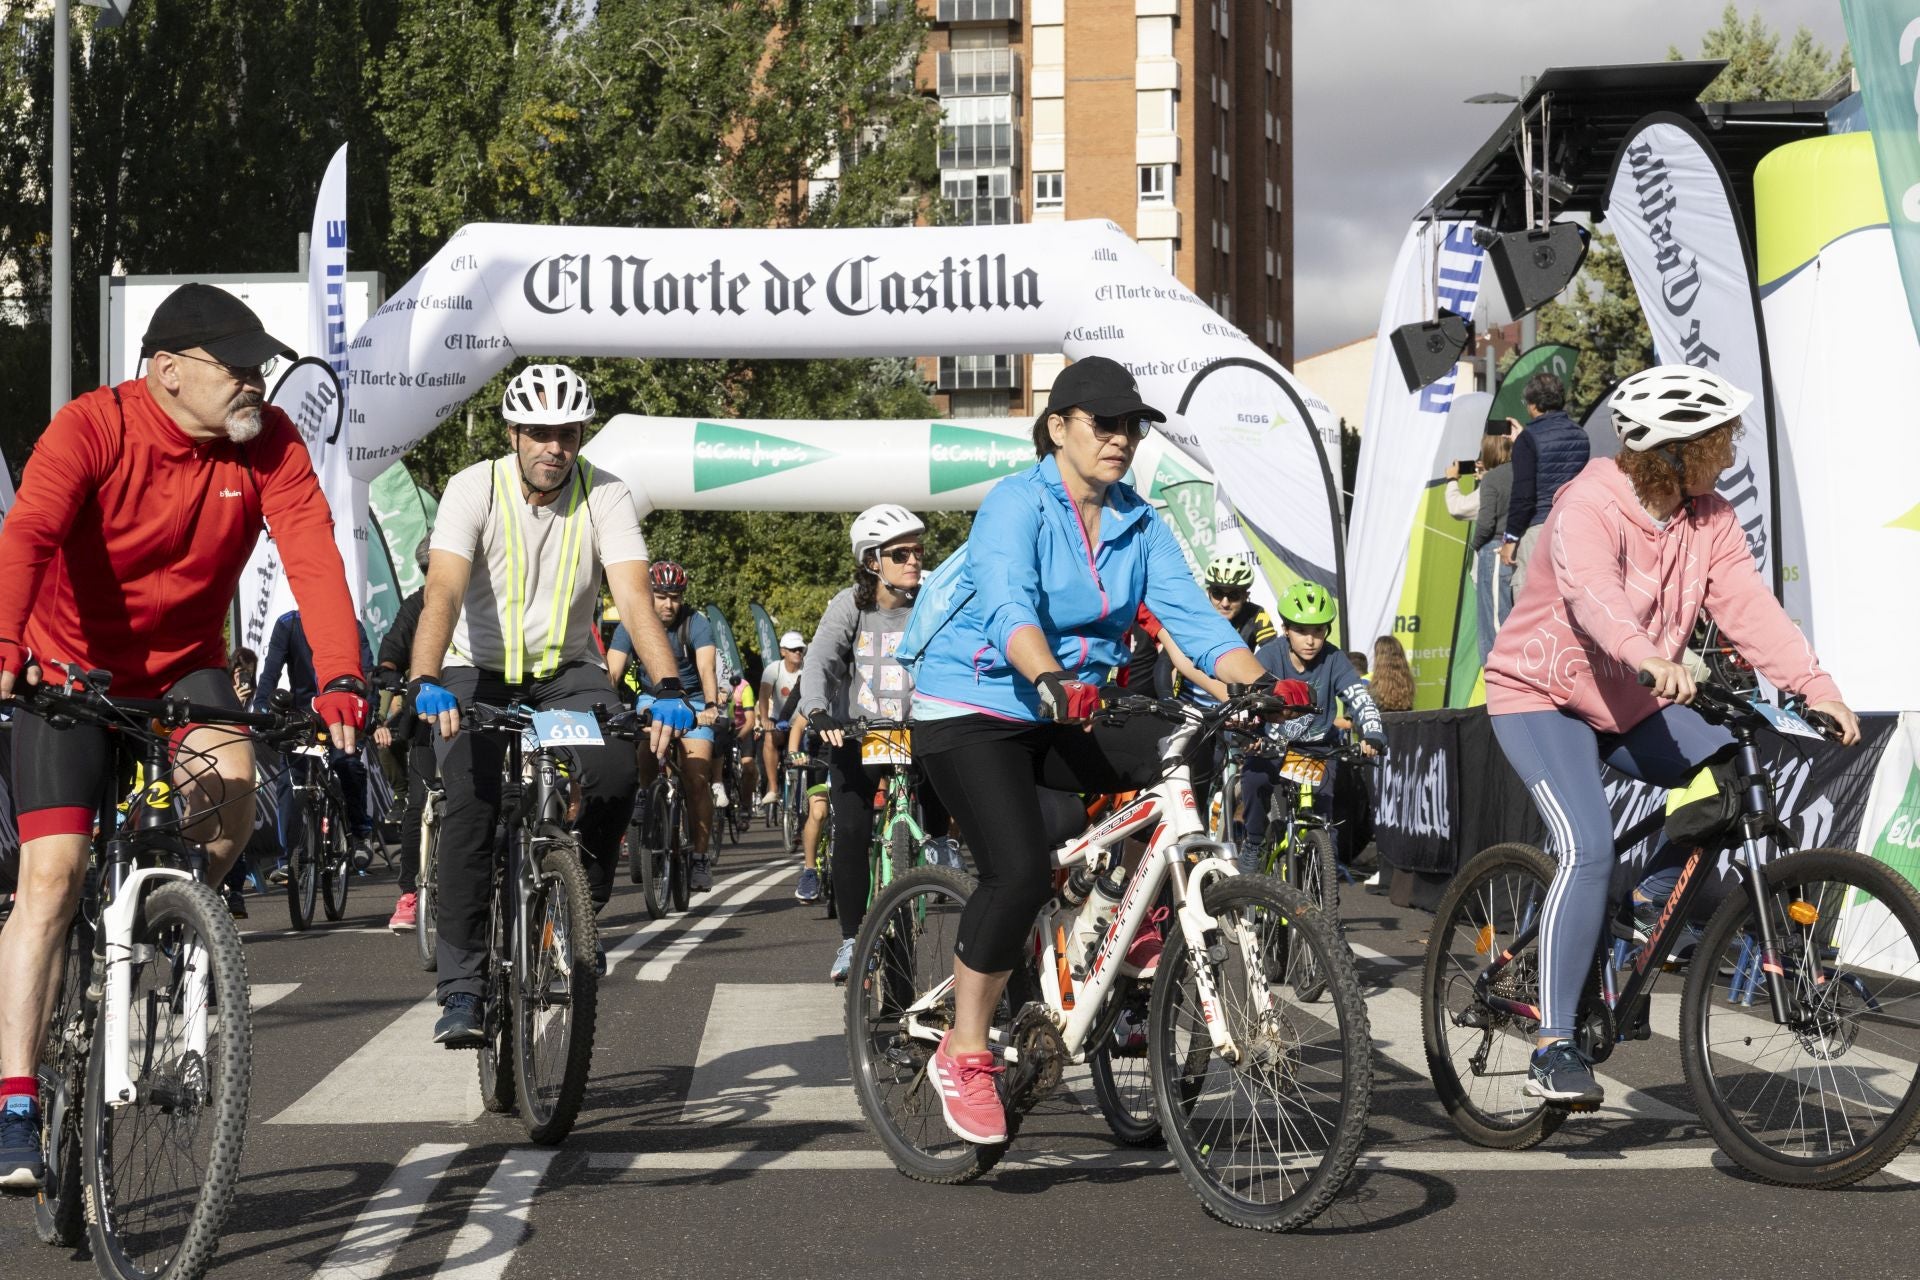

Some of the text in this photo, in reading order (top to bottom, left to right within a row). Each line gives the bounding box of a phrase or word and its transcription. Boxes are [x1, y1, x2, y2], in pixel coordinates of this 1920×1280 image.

[1092, 248, 1117, 262] tilla
[522, 253, 1045, 317] El Norte de Castilla
[1095, 285, 1112, 301] El
[1116, 285, 1151, 300] Norte
[1152, 287, 1166, 298] de
[406, 298, 418, 310] de
[420, 294, 473, 311] Castilla
[1073, 325, 1125, 342] Castilla
[1202, 322, 1217, 336] El
[444, 333, 462, 350] El
[466, 333, 501, 350] Norte
[1122, 359, 1159, 377] Norte
[1159, 361, 1174, 375] de
[360, 370, 397, 387] Norte
[399, 372, 413, 387] de
[415, 371, 466, 388] Castilla
[356, 445, 391, 461] Norte
[712, 442, 751, 461] Corte
[948, 444, 987, 462] Corte
[1394, 614, 1421, 633] na
[550, 724, 590, 739] 610
[1287, 763, 1322, 781] 1227
